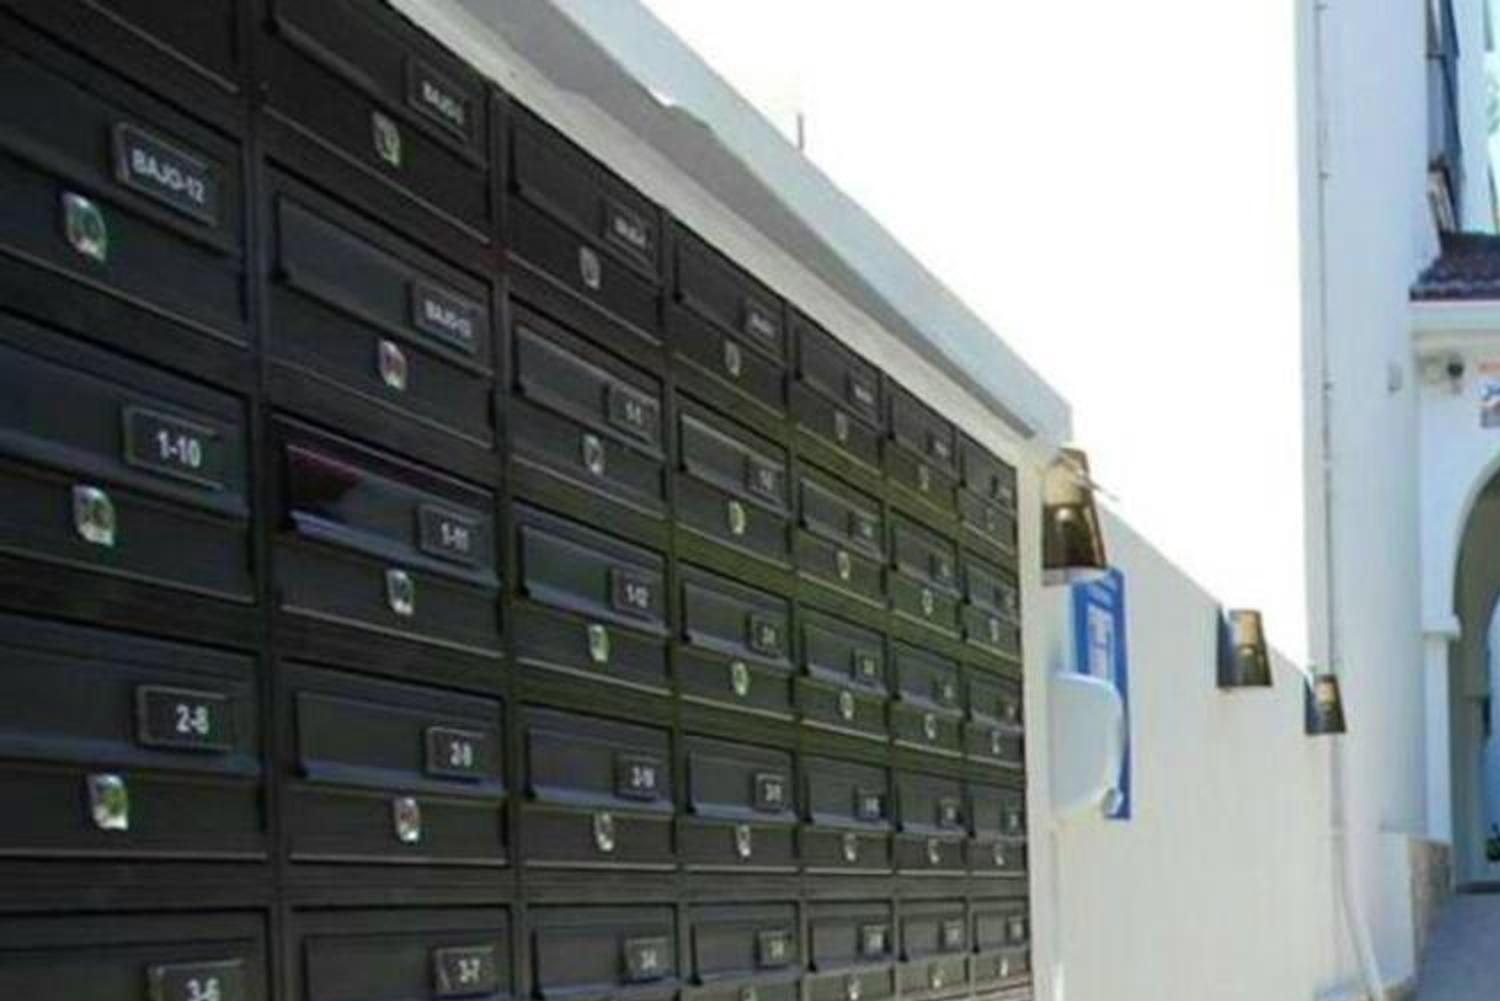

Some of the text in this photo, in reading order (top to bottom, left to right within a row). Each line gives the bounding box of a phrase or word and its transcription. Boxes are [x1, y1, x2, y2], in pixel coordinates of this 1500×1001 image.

[131, 149, 205, 203] BAJO-12
[157, 431, 201, 468] 1-10
[175, 705, 209, 735] 2-8
